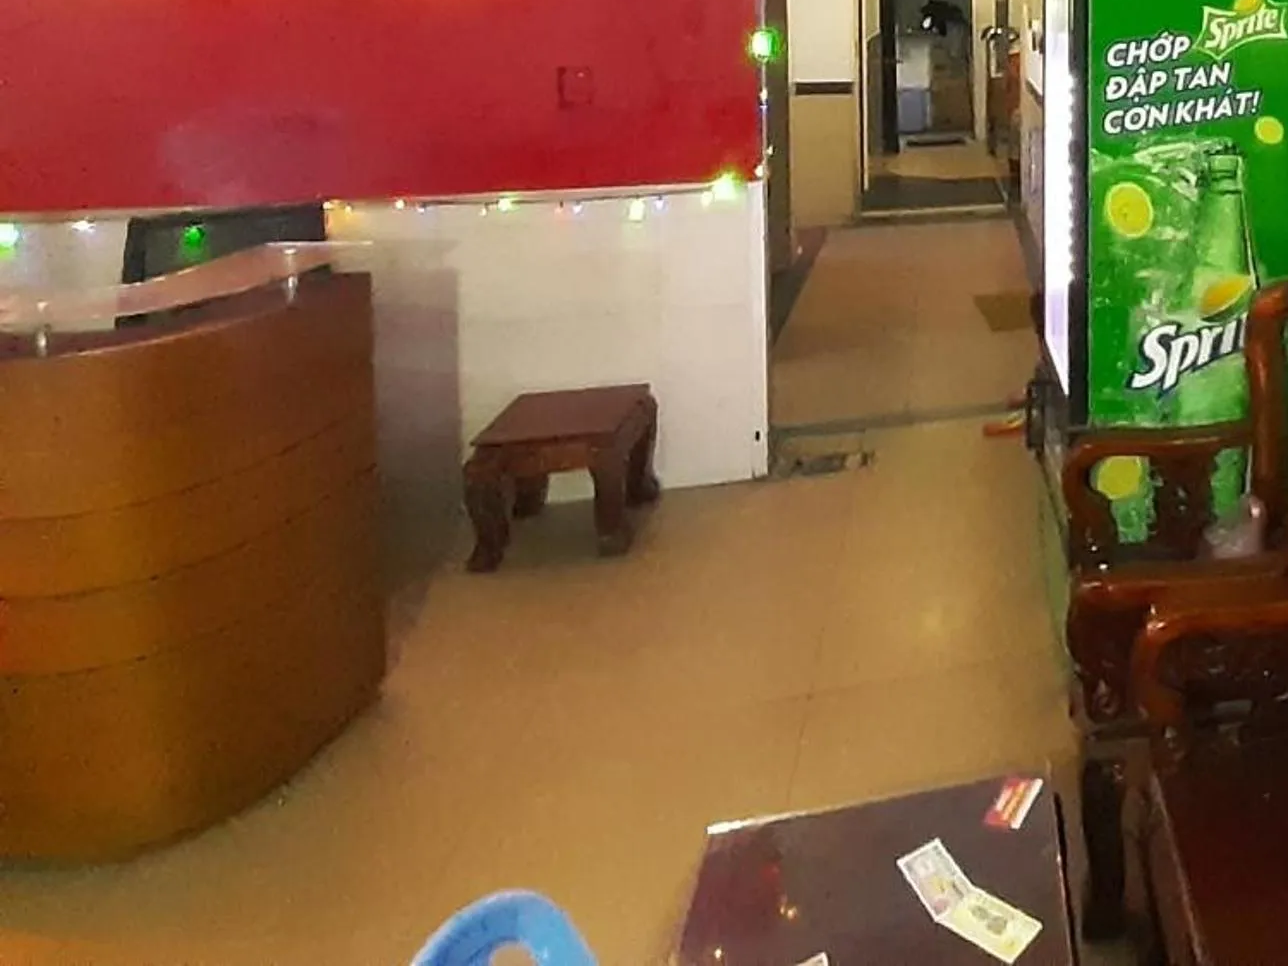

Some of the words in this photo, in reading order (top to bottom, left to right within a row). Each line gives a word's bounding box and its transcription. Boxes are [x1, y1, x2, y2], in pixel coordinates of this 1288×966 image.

[1204, 4, 1279, 49] Sprite
[1106, 31, 1191, 67] CHỚP
[1105, 67, 1167, 102] ĐẬP
[1174, 62, 1231, 91] TAN
[1175, 89, 1261, 125] KHÁT!
[1131, 311, 1248, 390] Spri
